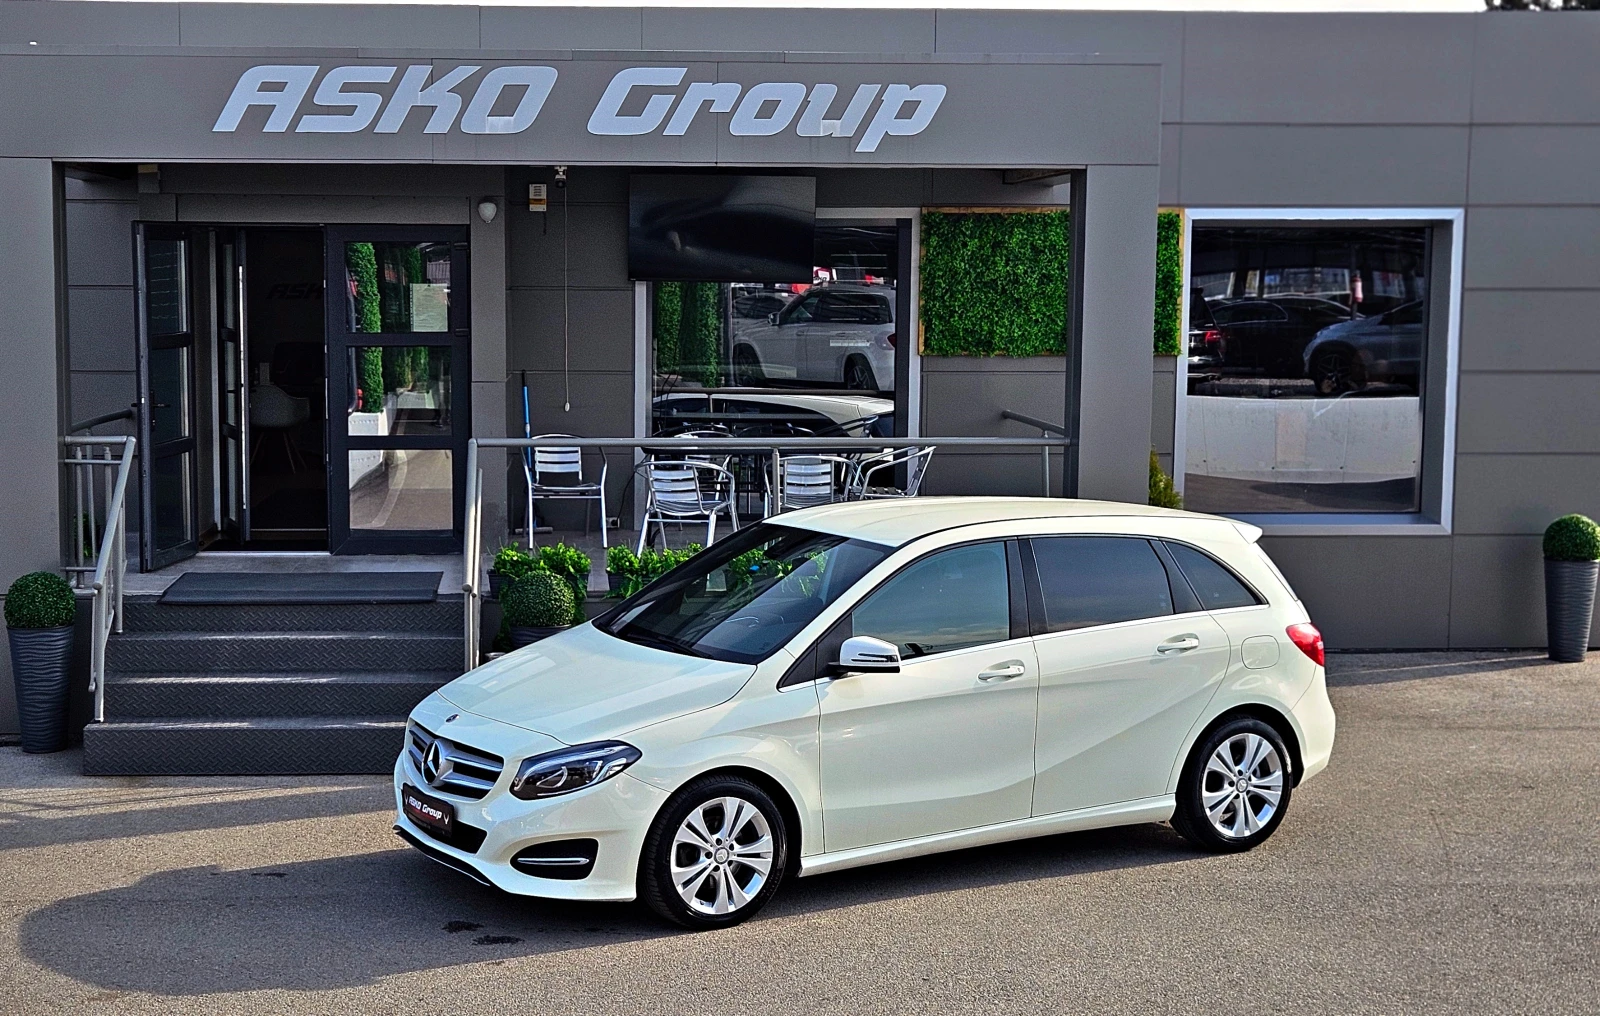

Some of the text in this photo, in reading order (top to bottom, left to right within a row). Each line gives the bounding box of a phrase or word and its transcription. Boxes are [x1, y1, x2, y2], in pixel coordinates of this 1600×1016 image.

[212, 65, 947, 152] ASKO Group
[422, 803, 442, 820] Group
